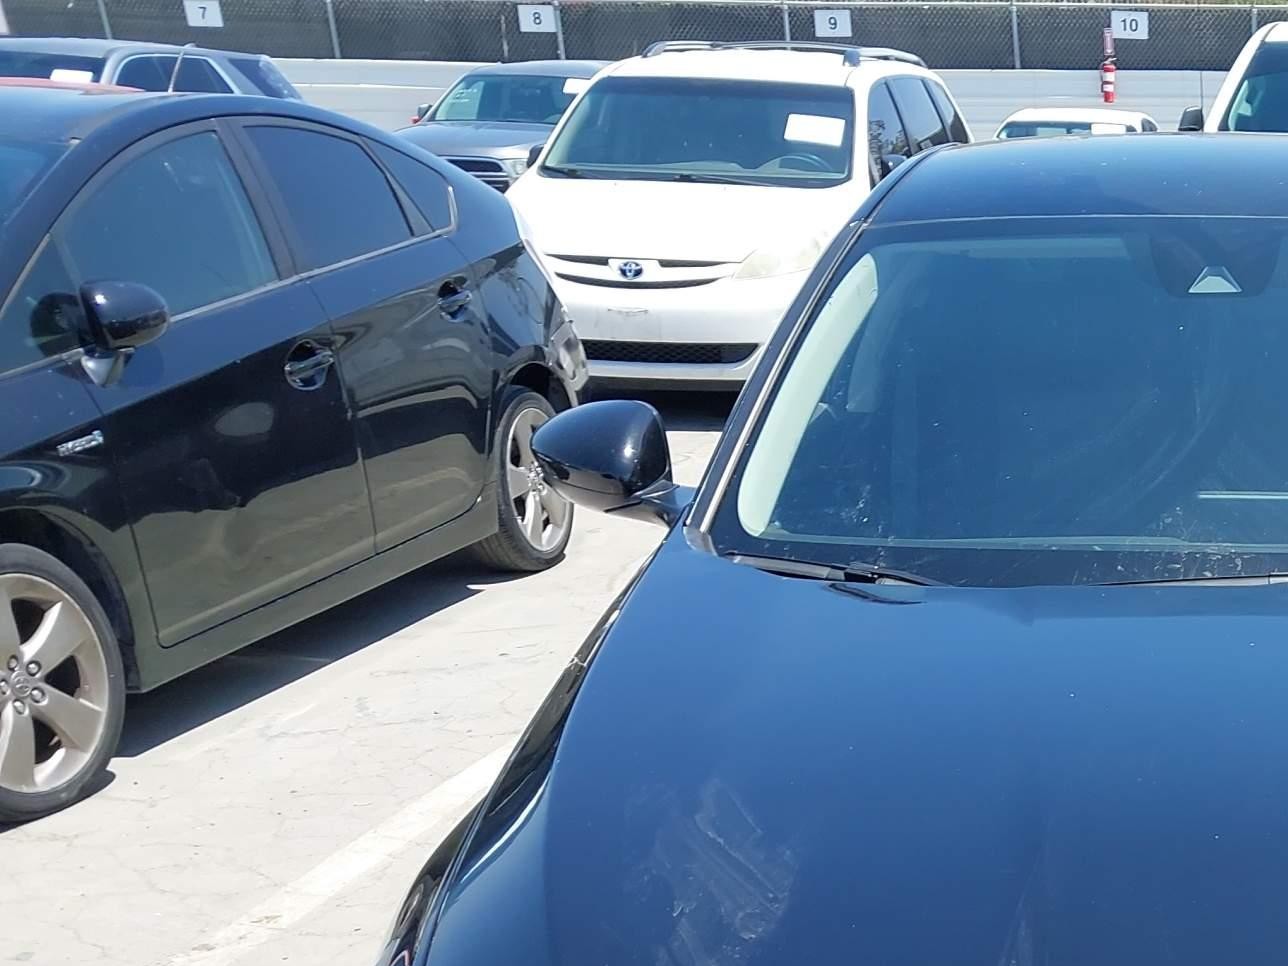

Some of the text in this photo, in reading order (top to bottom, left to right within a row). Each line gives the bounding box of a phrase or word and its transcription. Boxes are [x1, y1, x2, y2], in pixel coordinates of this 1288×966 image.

[197, 6, 207, 20] 7
[532, 11, 542, 25] 8
[828, 16, 838, 30] 9
[1120, 18, 1138, 32] 10
